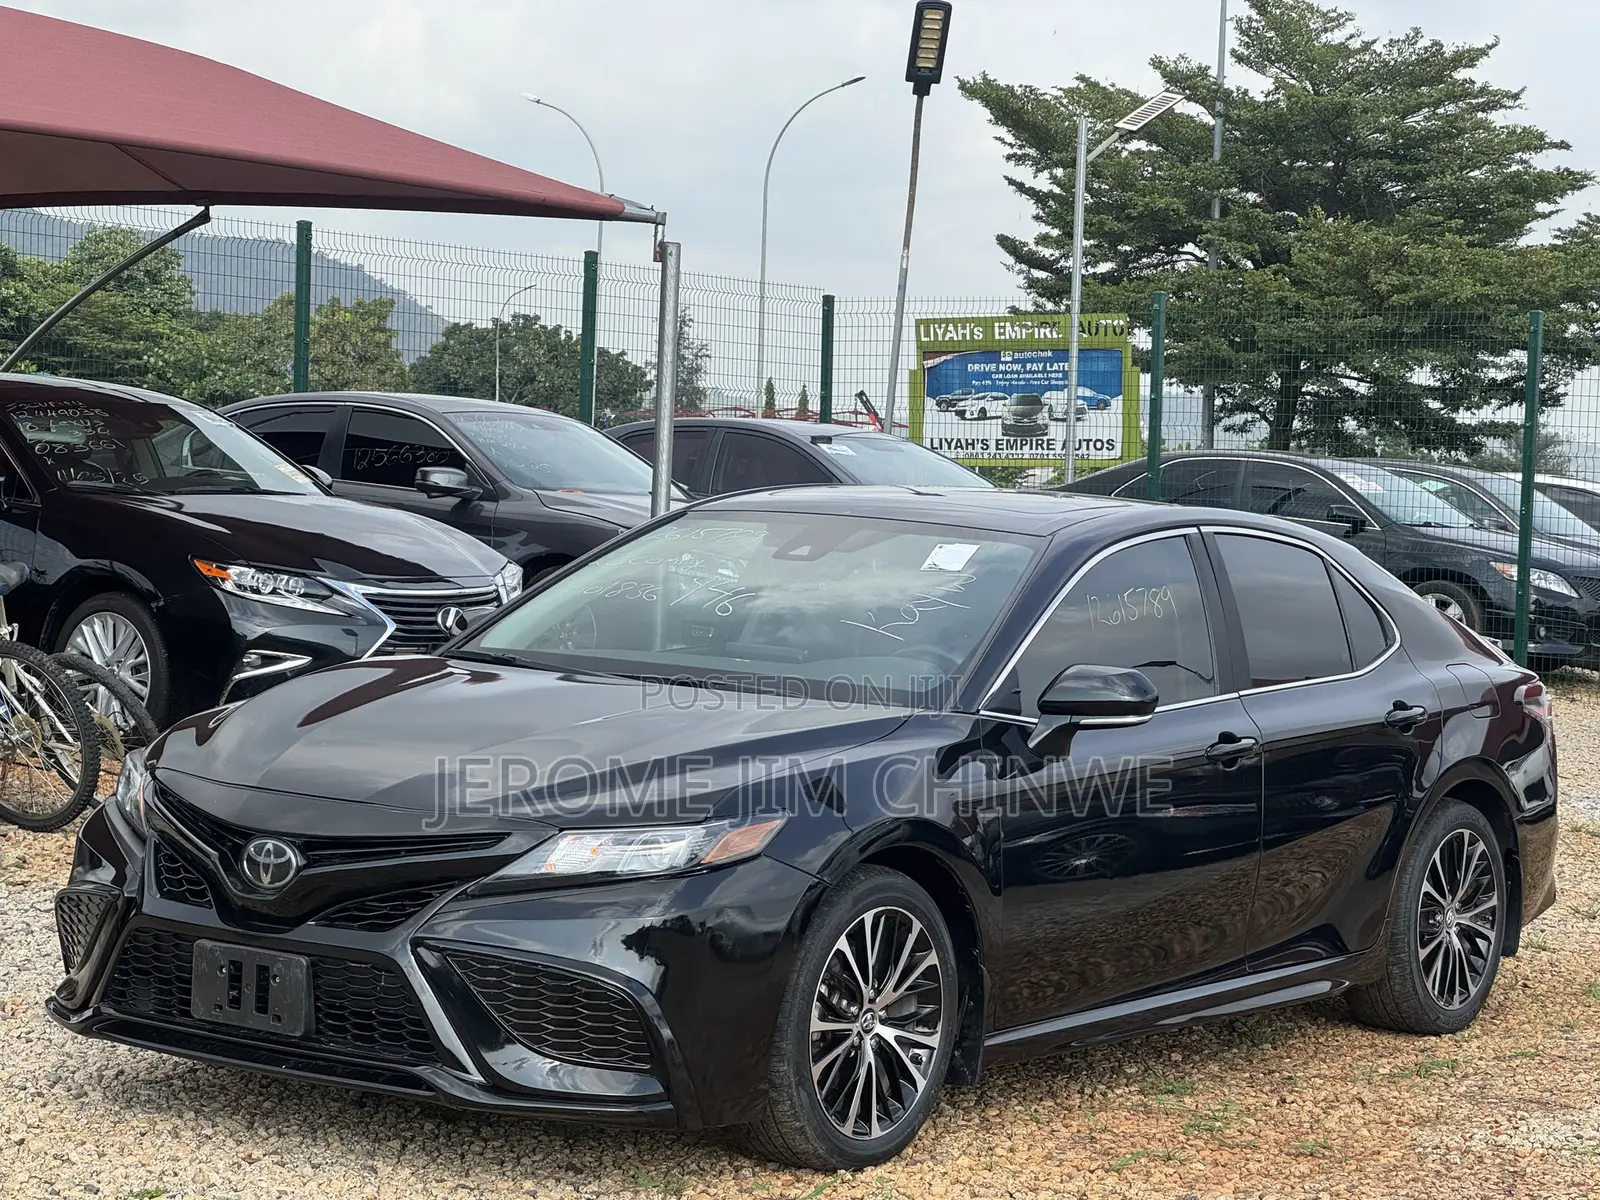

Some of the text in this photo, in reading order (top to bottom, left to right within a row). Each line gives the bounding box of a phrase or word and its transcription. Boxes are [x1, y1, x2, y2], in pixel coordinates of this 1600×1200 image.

[920, 322, 984, 341] LIYAH's
[994, 321, 1063, 340] EMPIRE
[1013, 350, 1053, 359] autochek
[967, 362, 1070, 372] DRIVE NOW, PAY LATE
[929, 437, 990, 451] LIYAH'S
[995, 437, 1056, 451] EMPIRE
